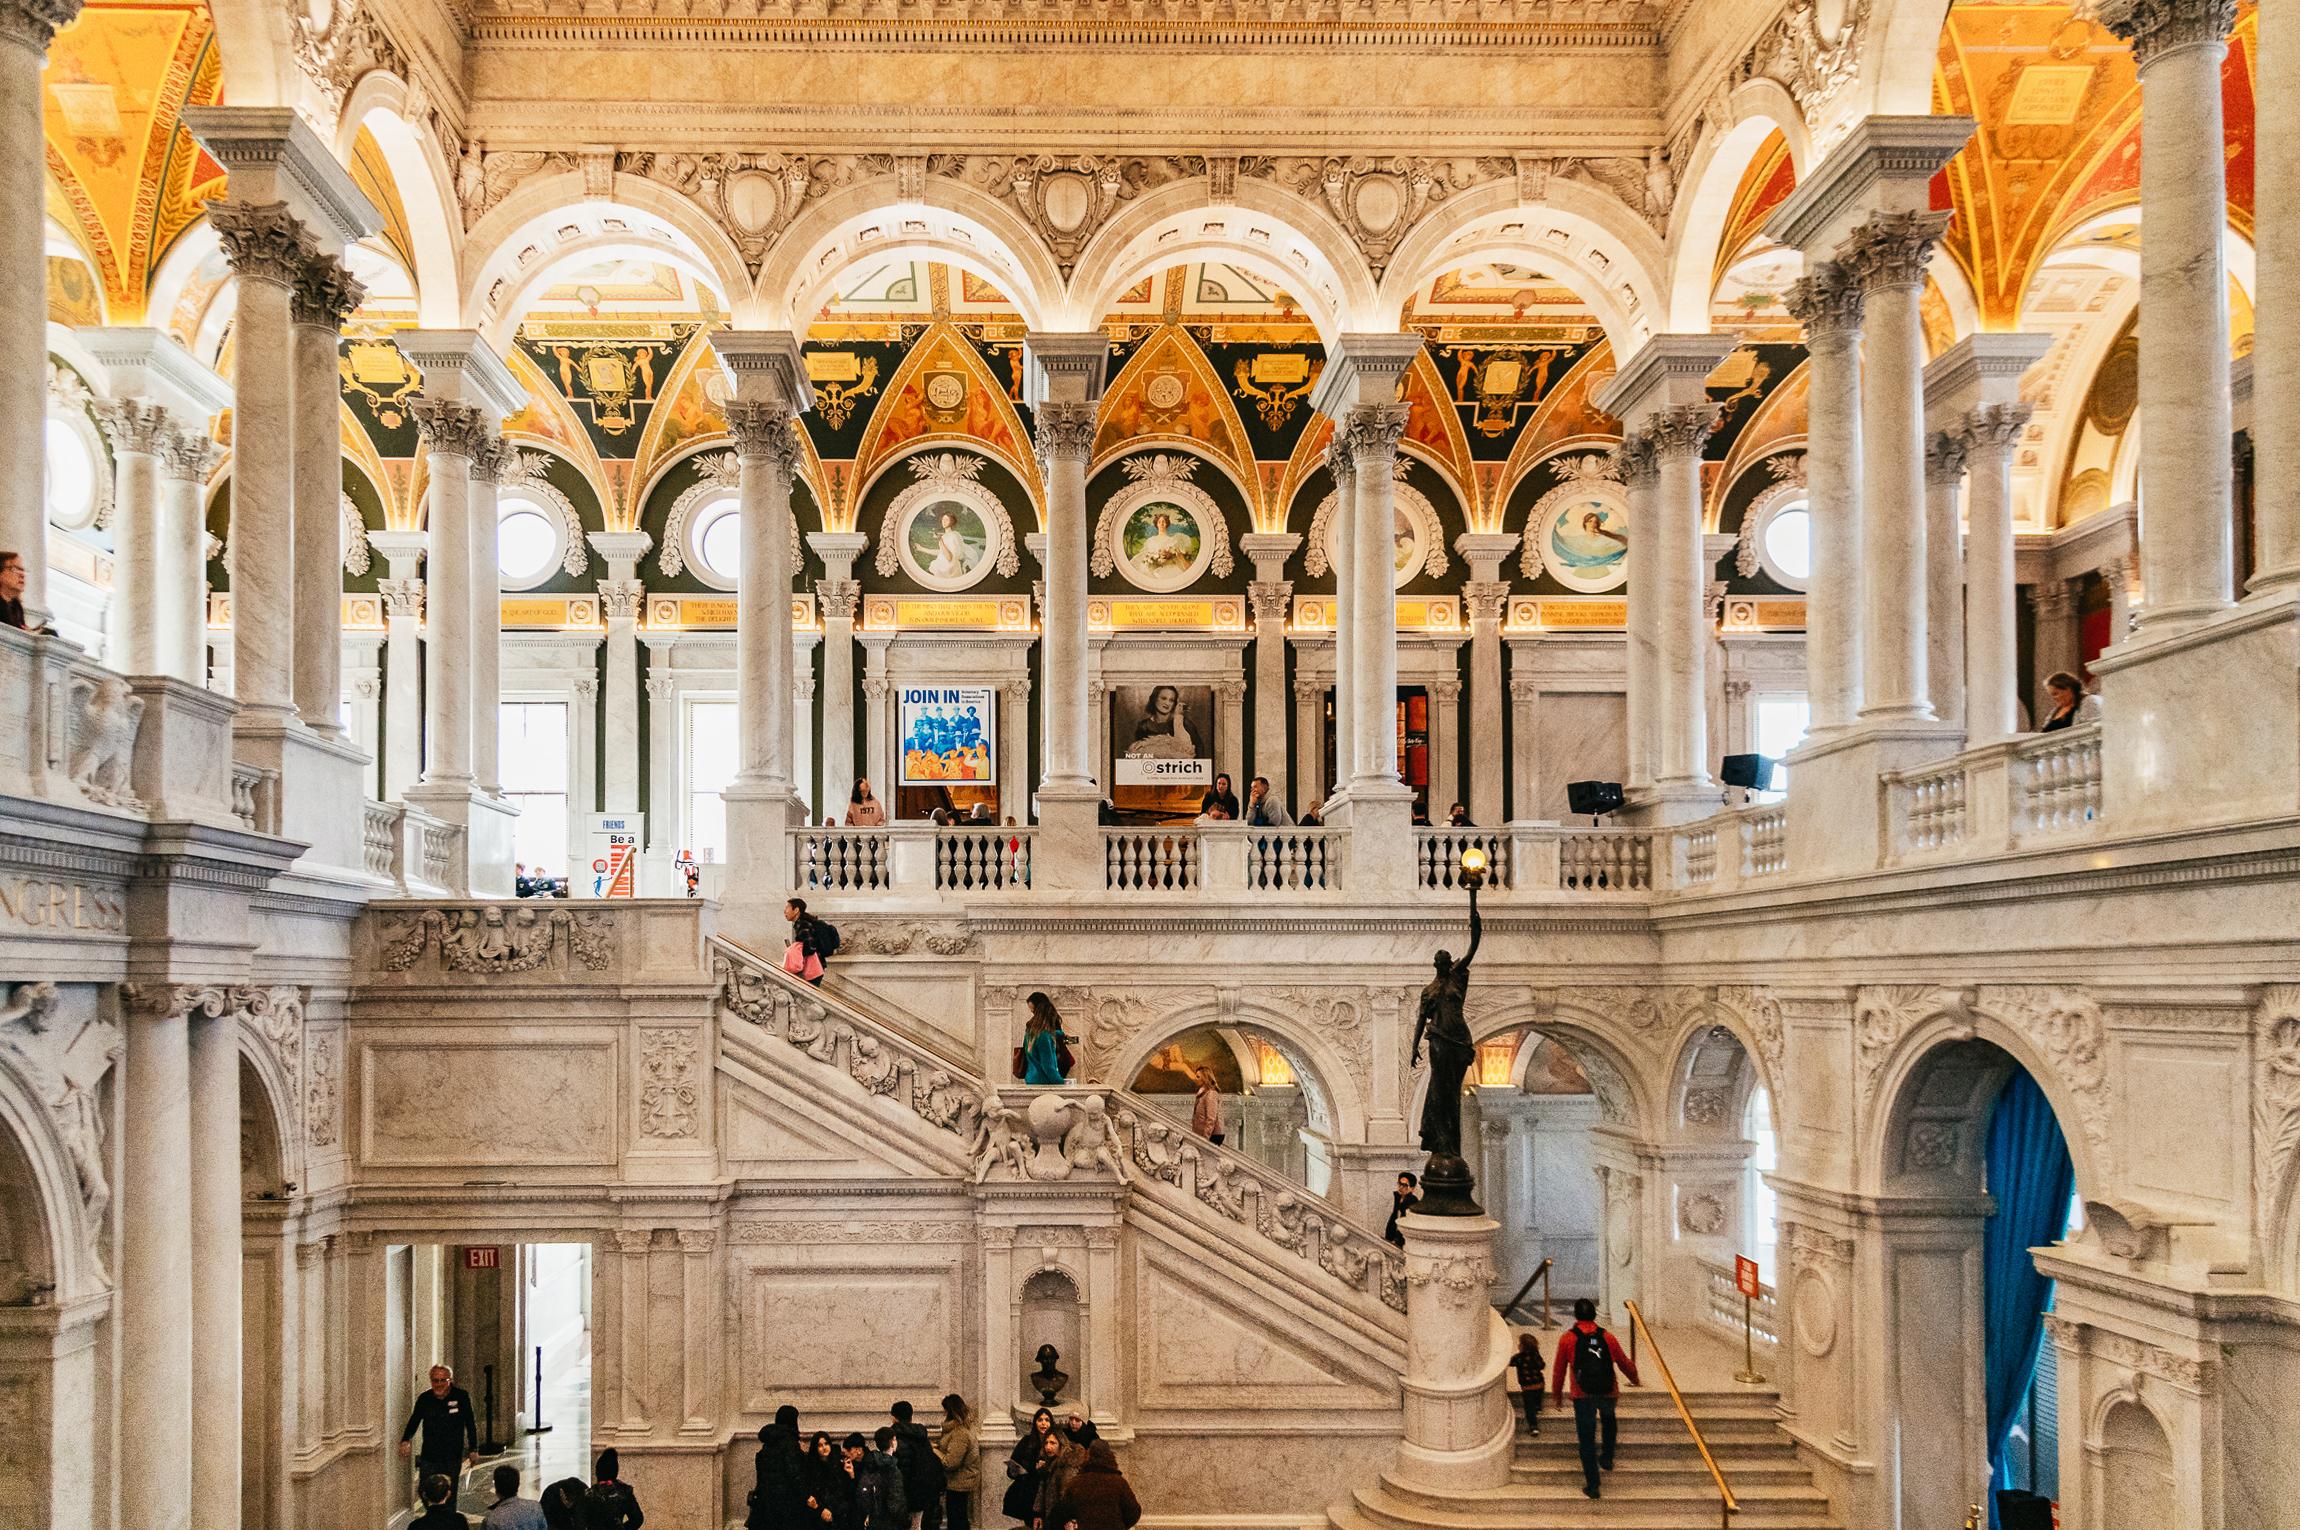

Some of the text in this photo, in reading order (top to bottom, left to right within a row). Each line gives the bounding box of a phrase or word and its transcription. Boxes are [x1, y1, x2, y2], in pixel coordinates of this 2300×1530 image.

[903, 689, 959, 704] JOIN IN
[1143, 761, 1202, 774] Ostrich
[611, 835, 625, 843] Be
[470, 1249, 495, 1267] EXIT
